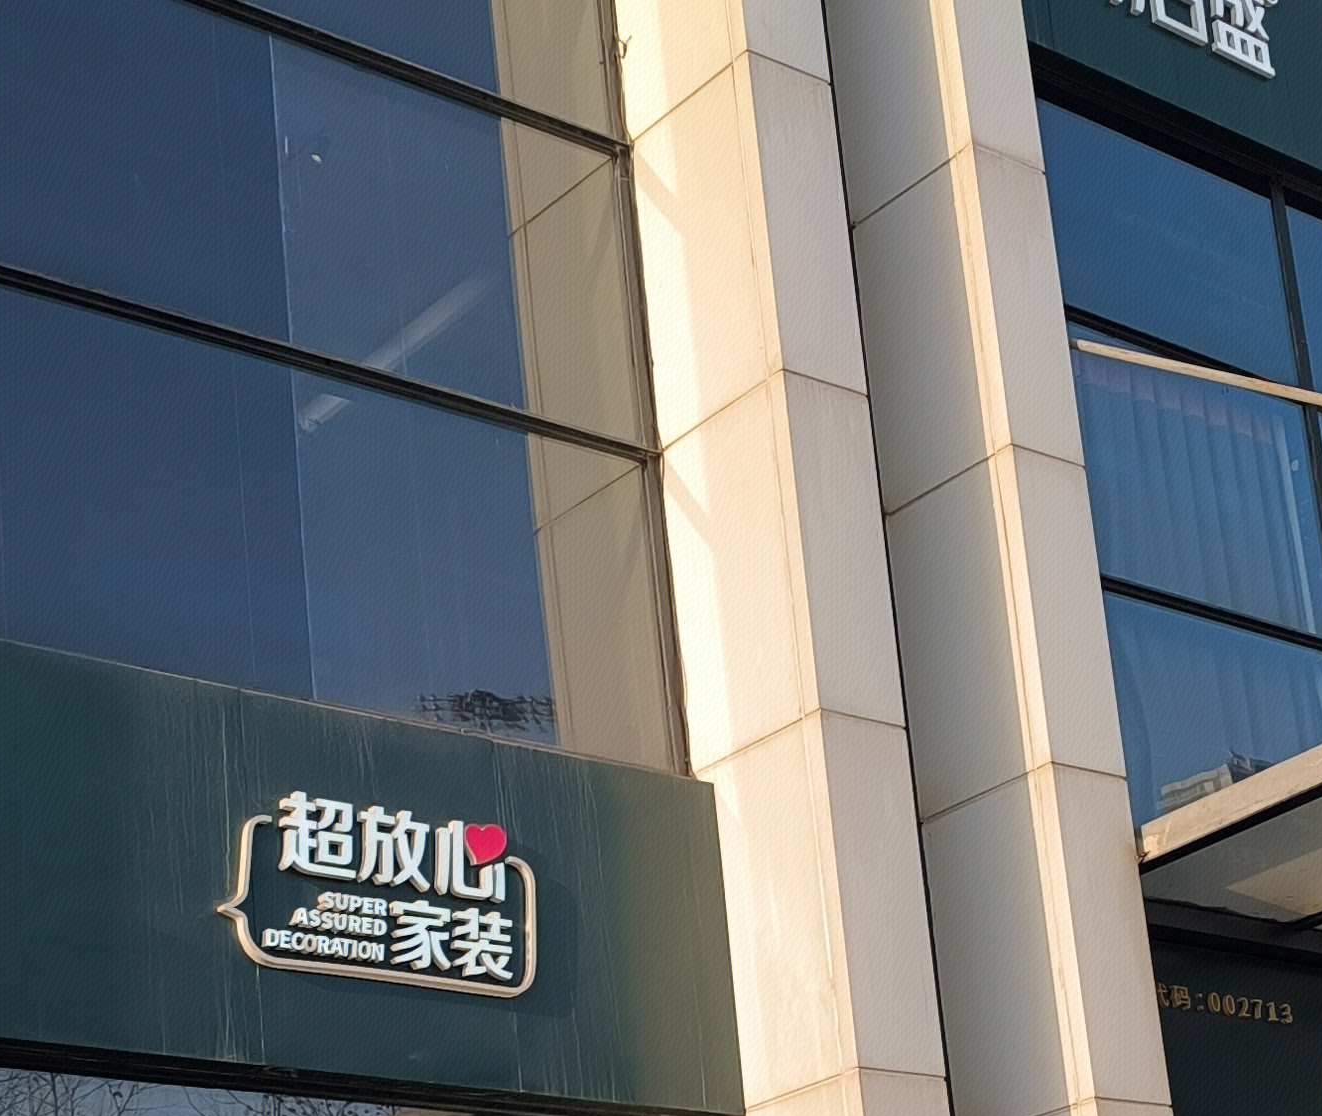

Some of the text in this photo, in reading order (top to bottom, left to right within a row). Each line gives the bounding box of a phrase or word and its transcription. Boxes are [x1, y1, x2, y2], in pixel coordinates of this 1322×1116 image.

[278, 791, 508, 904] 超放心
[317, 891, 388, 917] SUPER
[289, 907, 388, 937] ASSURED
[261, 928, 386, 962] DECORATION
[389, 899, 514, 981] 家装
